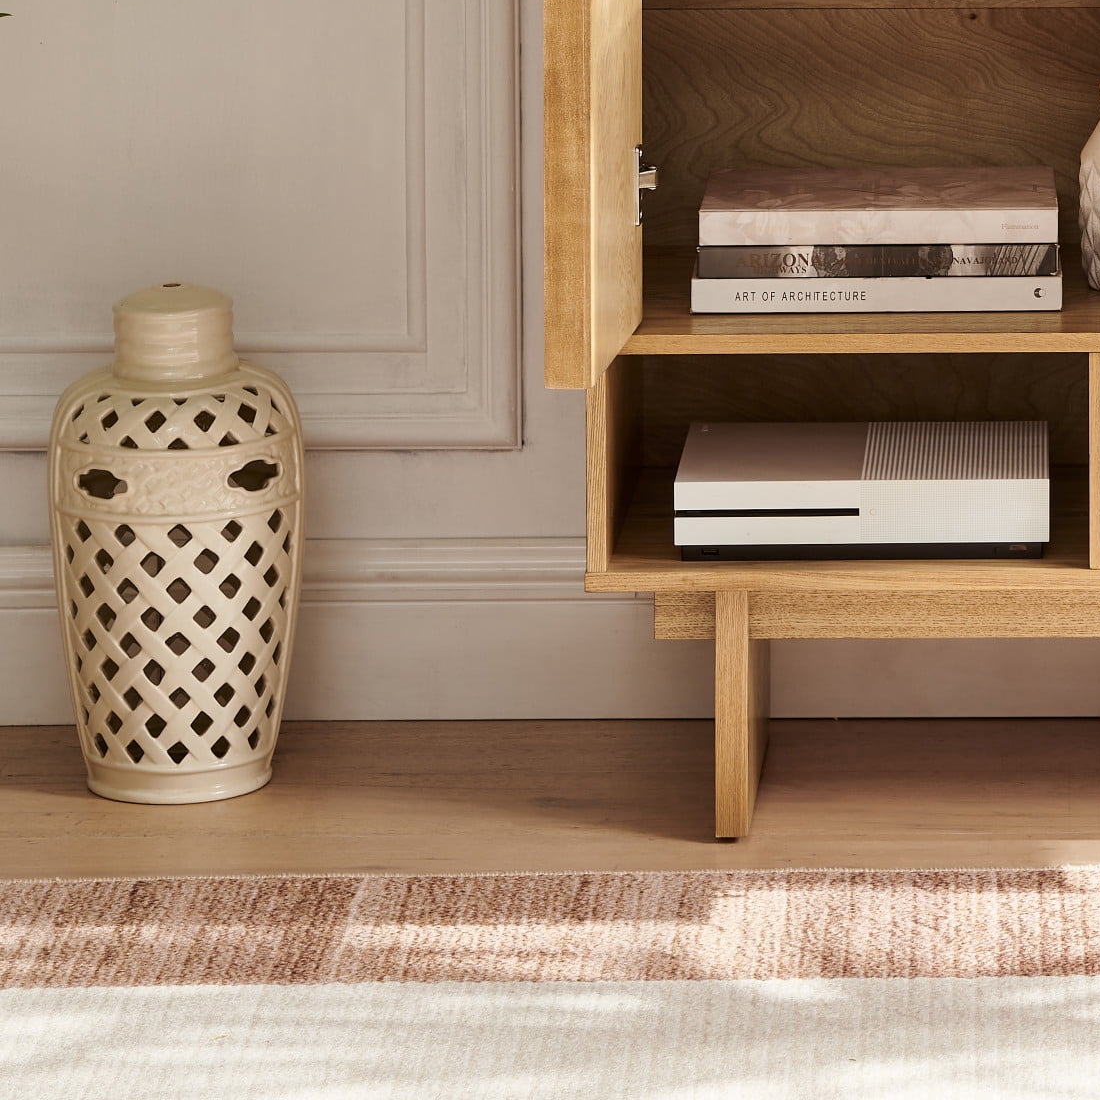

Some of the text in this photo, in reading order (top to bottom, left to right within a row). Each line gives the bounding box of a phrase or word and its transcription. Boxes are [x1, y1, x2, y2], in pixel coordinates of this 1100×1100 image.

[735, 291, 867, 301] ART OF ARCHITECTURE
